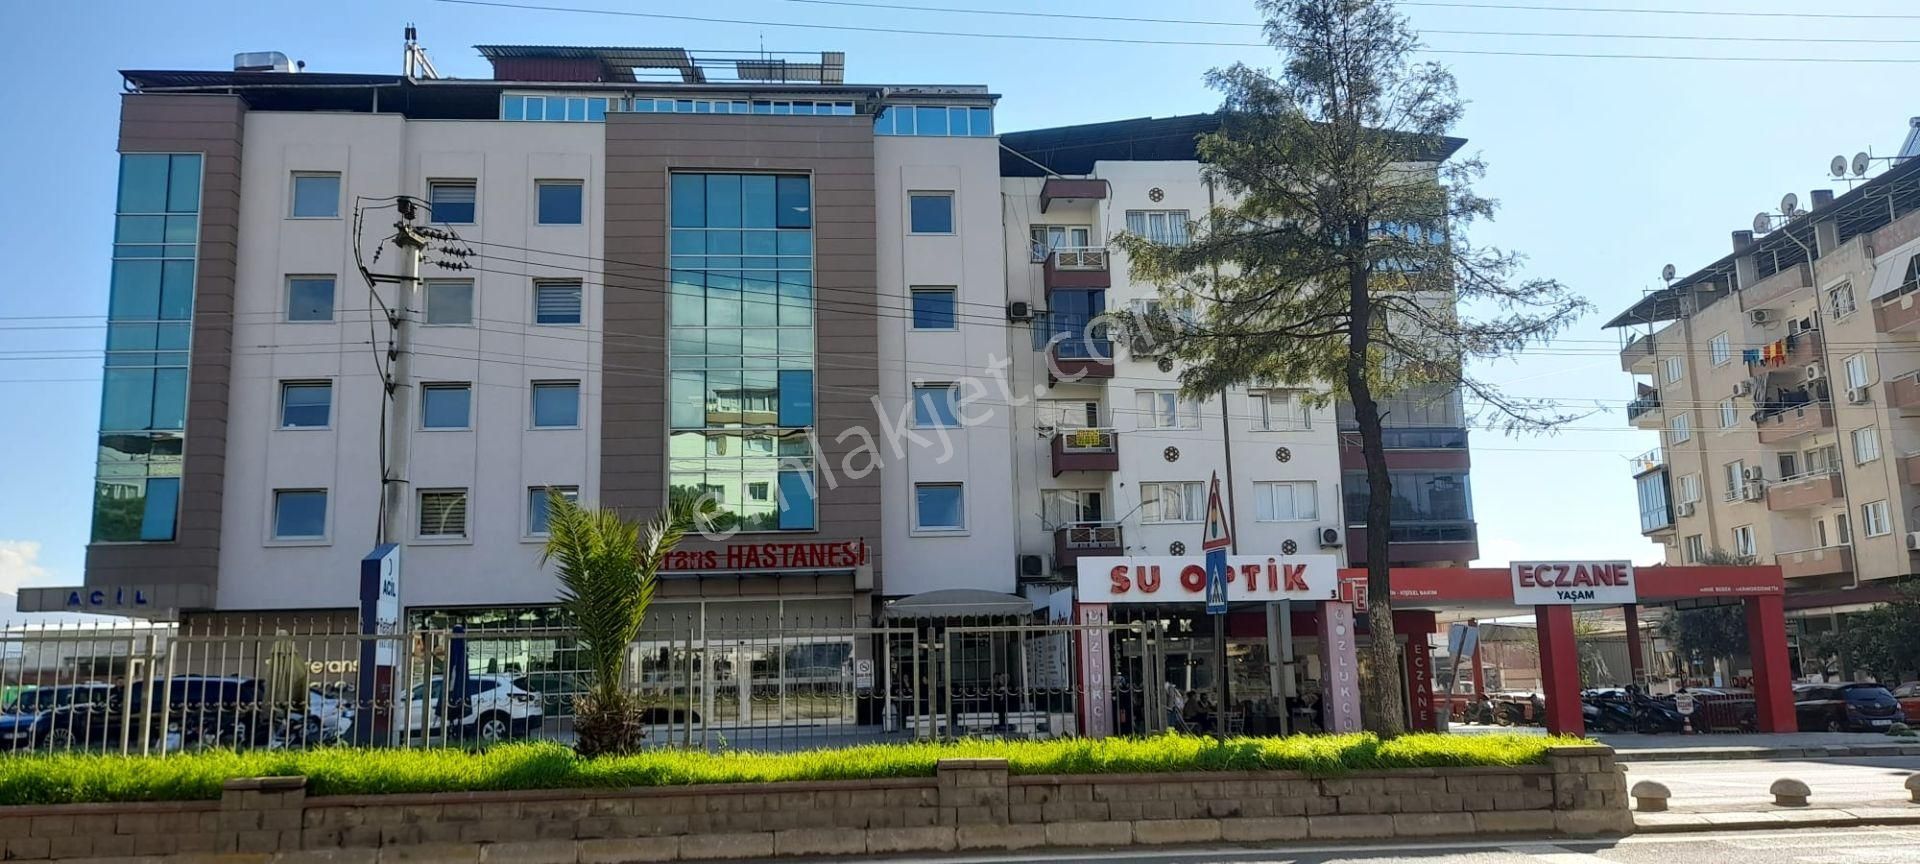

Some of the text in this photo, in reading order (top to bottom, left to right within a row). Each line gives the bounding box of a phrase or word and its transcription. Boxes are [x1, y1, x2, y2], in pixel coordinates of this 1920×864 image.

[727, 537, 865, 570] HASTANESİ
[382, 578, 396, 598] ACİL
[1110, 564, 1161, 593] SU
[1518, 563, 1629, 588] ECZANE
[67, 585, 147, 606] ACİL
[1557, 590, 1595, 602] YAŞAM
[1414, 644, 1428, 720] ECZANE
